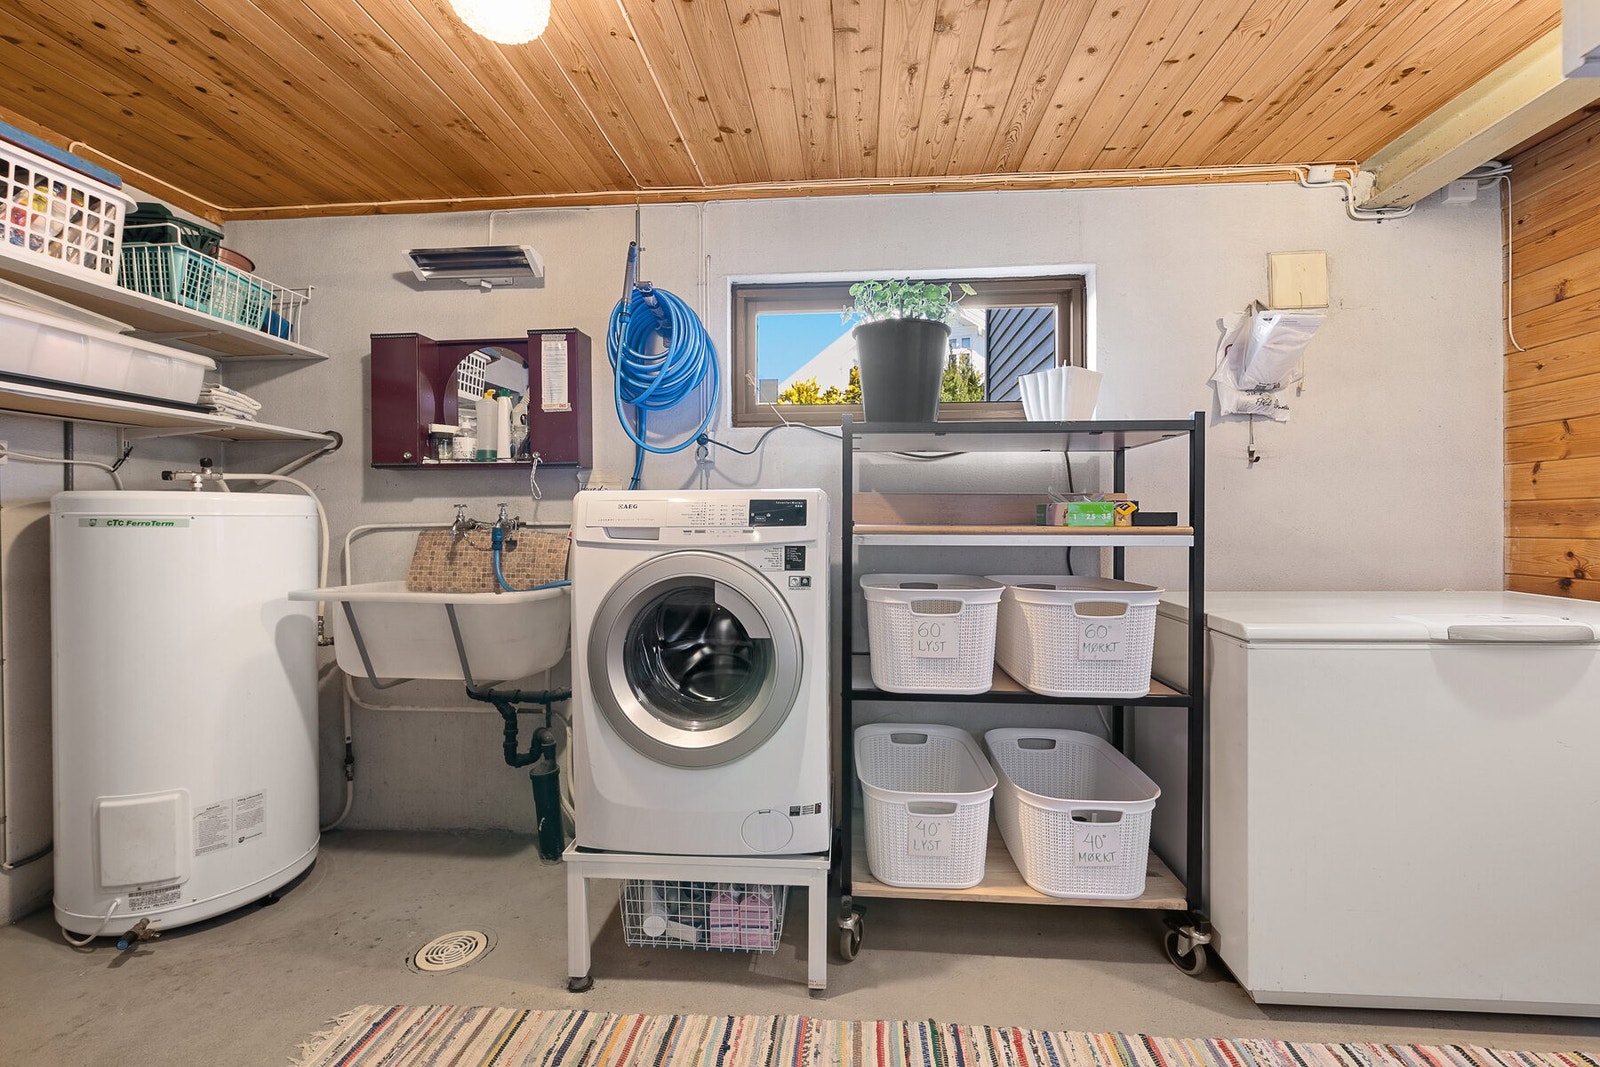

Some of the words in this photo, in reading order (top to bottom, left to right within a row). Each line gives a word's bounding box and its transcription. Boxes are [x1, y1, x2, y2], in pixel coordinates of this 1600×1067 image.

[106, 519, 124, 527] CTC
[918, 640, 947, 652] LYST
[1082, 641, 1121, 653] MØRKT
[913, 839, 942, 851] LYST
[1078, 851, 1116, 863] MØRKT
